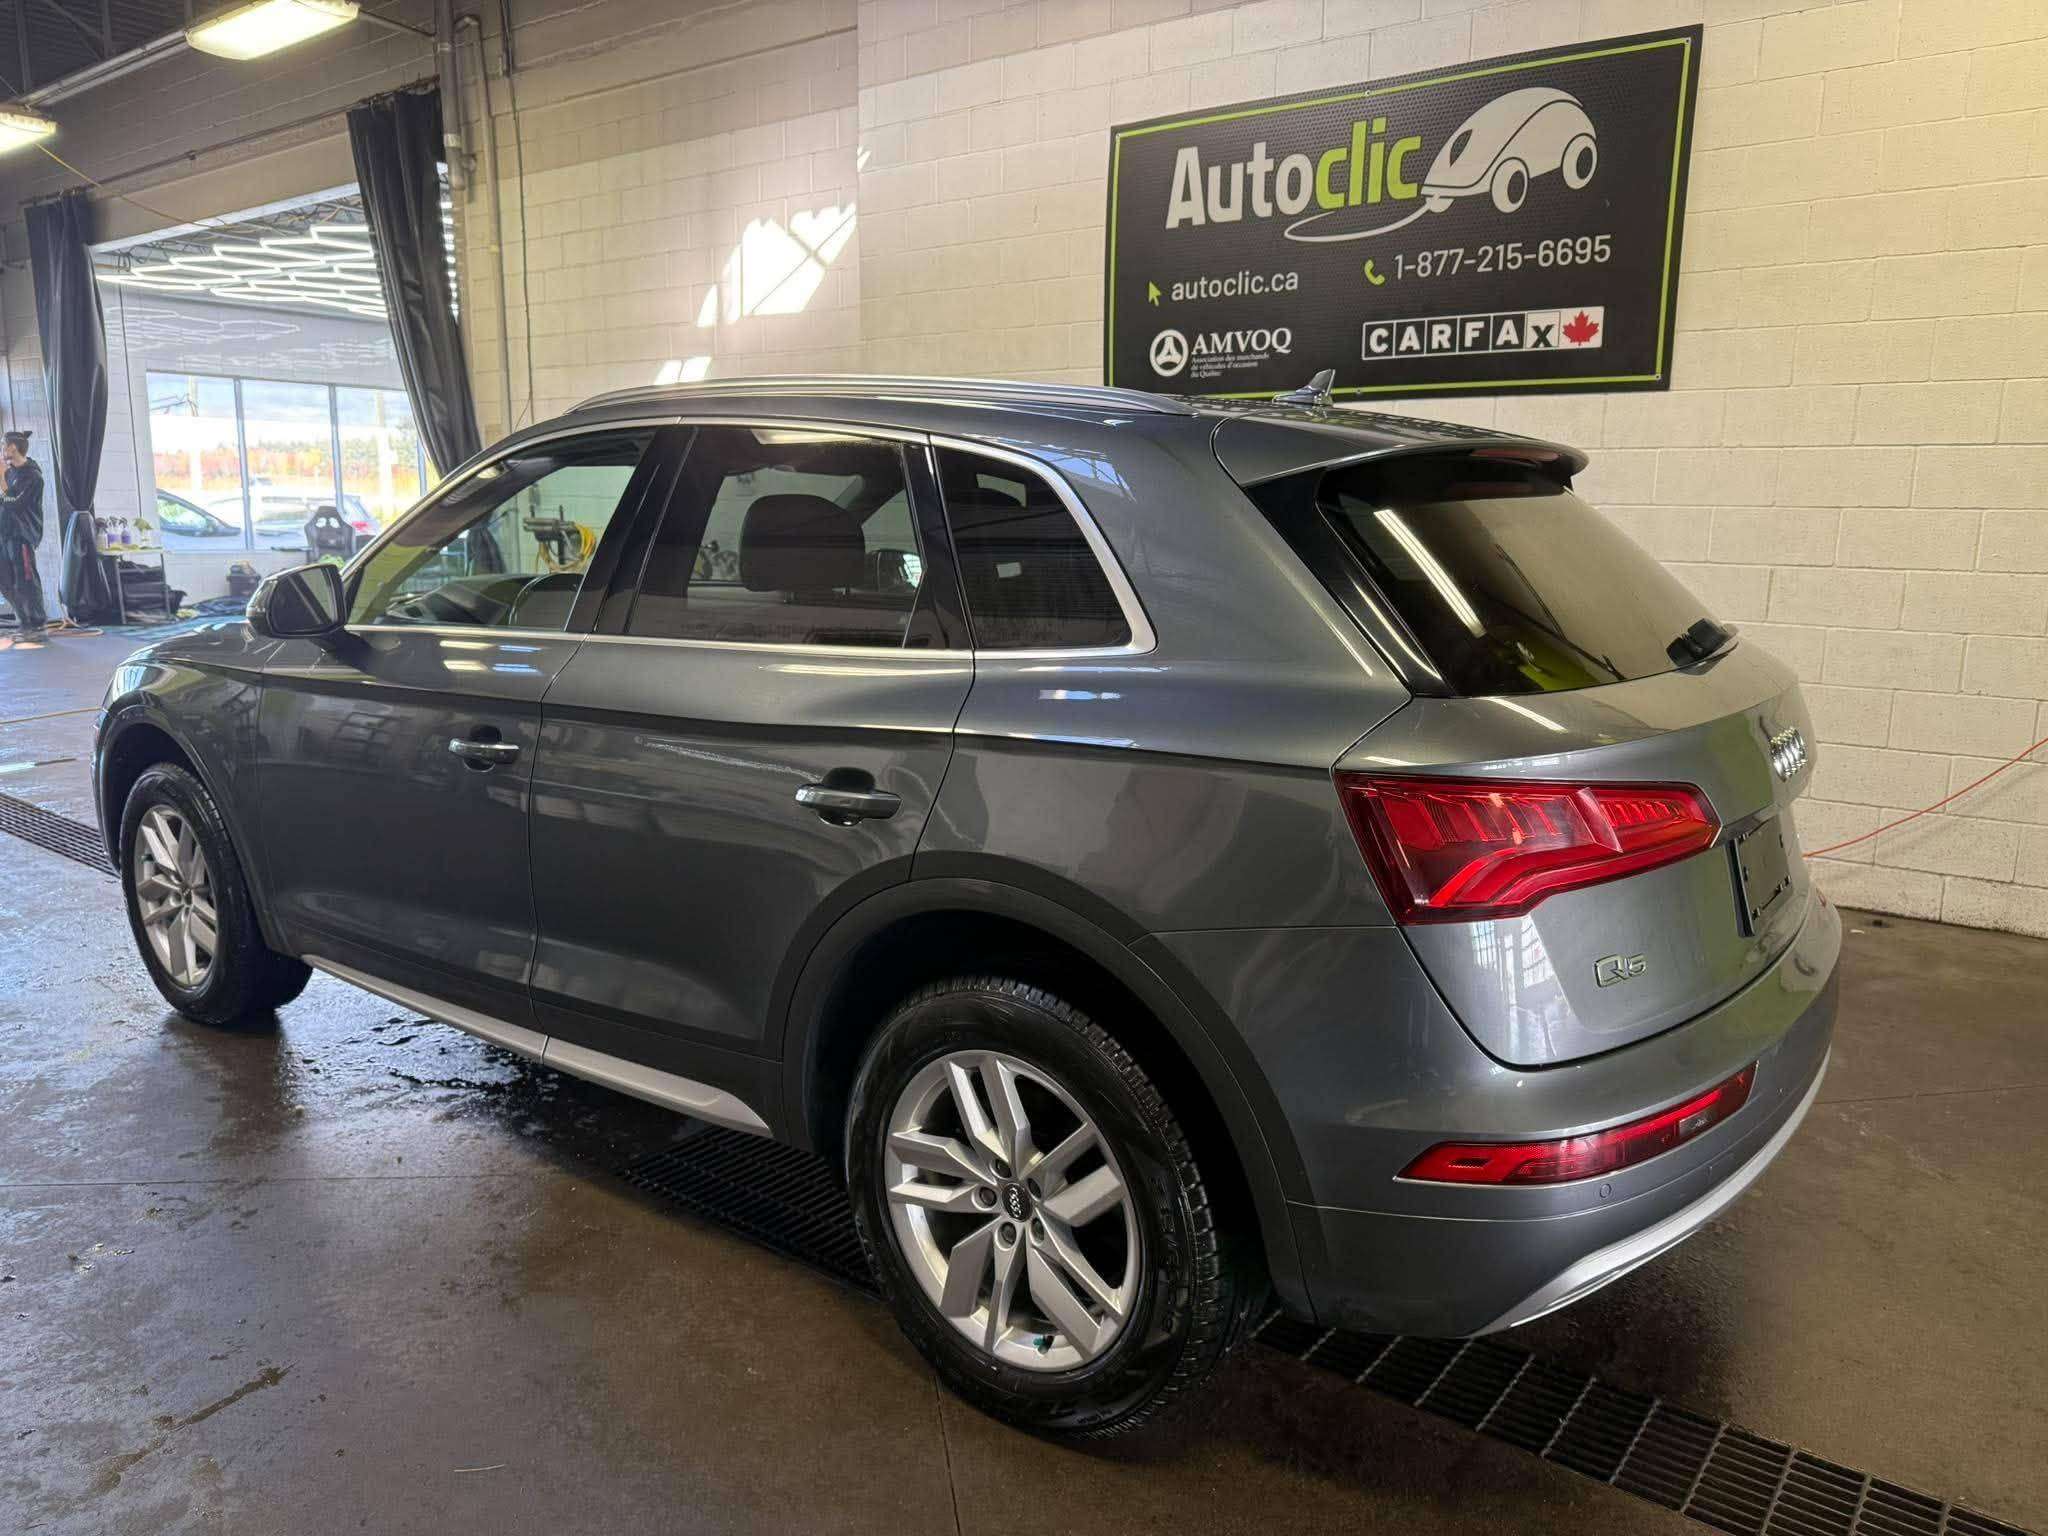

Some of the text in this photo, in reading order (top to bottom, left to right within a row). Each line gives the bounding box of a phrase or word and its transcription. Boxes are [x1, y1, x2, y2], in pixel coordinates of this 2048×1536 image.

[1165, 116, 1422, 230] Autoclic
[1393, 234, 1612, 281] 1-877-215-6695
[1171, 270, 1299, 302] autoclic.ca
[1191, 327, 1292, 355] AMVOQ
[1366, 319, 1556, 355] CARFAX
[1594, 953, 1647, 988] Q5
